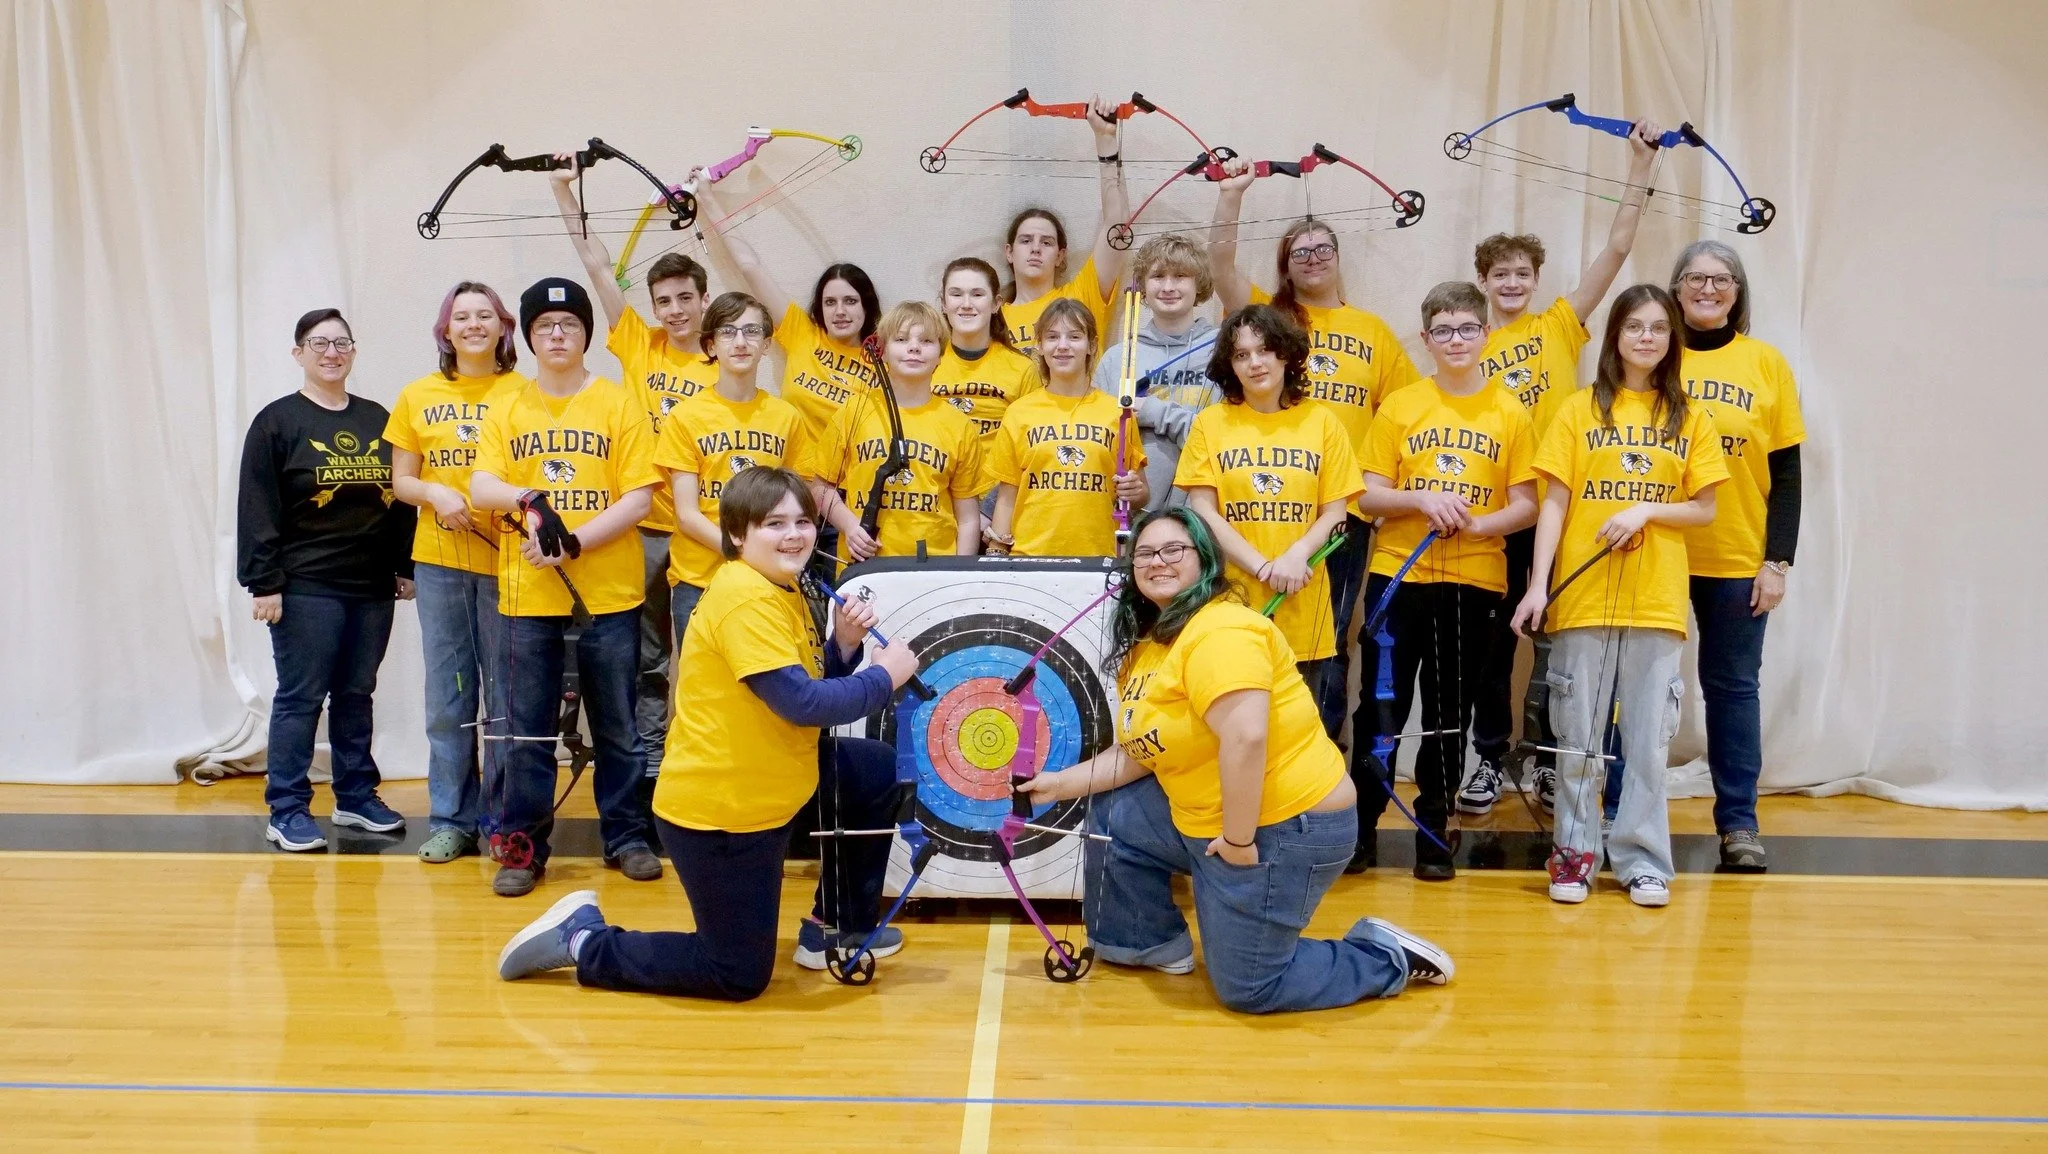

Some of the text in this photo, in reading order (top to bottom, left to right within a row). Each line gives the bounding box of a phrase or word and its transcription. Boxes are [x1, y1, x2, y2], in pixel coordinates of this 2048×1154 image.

[1313, 330, 1373, 365] LDEN
[813, 347, 881, 389] WALDEN
[1172, 370, 1204, 385] ARE
[793, 372, 855, 404] ARCHE
[1312, 381, 1368, 407] HERY
[1687, 380, 1753, 412] LDEN
[423, 403, 489, 426] WALD
[509, 429, 611, 461] WALDEN
[697, 430, 785, 459] WALDEN
[1027, 423, 1115, 452] WALDEN
[1407, 427, 1501, 463] WALDEN
[1585, 425, 1689, 459] WALDEN
[326, 456, 381, 466] WALDEN
[429, 448, 477, 467] ARCH
[856, 438, 948, 473] WADEN
[1216, 446, 1321, 476] WALDEN
[322, 468, 391, 481] ARCHERY
[543, 490, 610, 511] HERY
[855, 490, 940, 513] ACHERY
[1582, 480, 1677, 504] ARCHERY
[1225, 501, 1313, 523] ARCHERY
